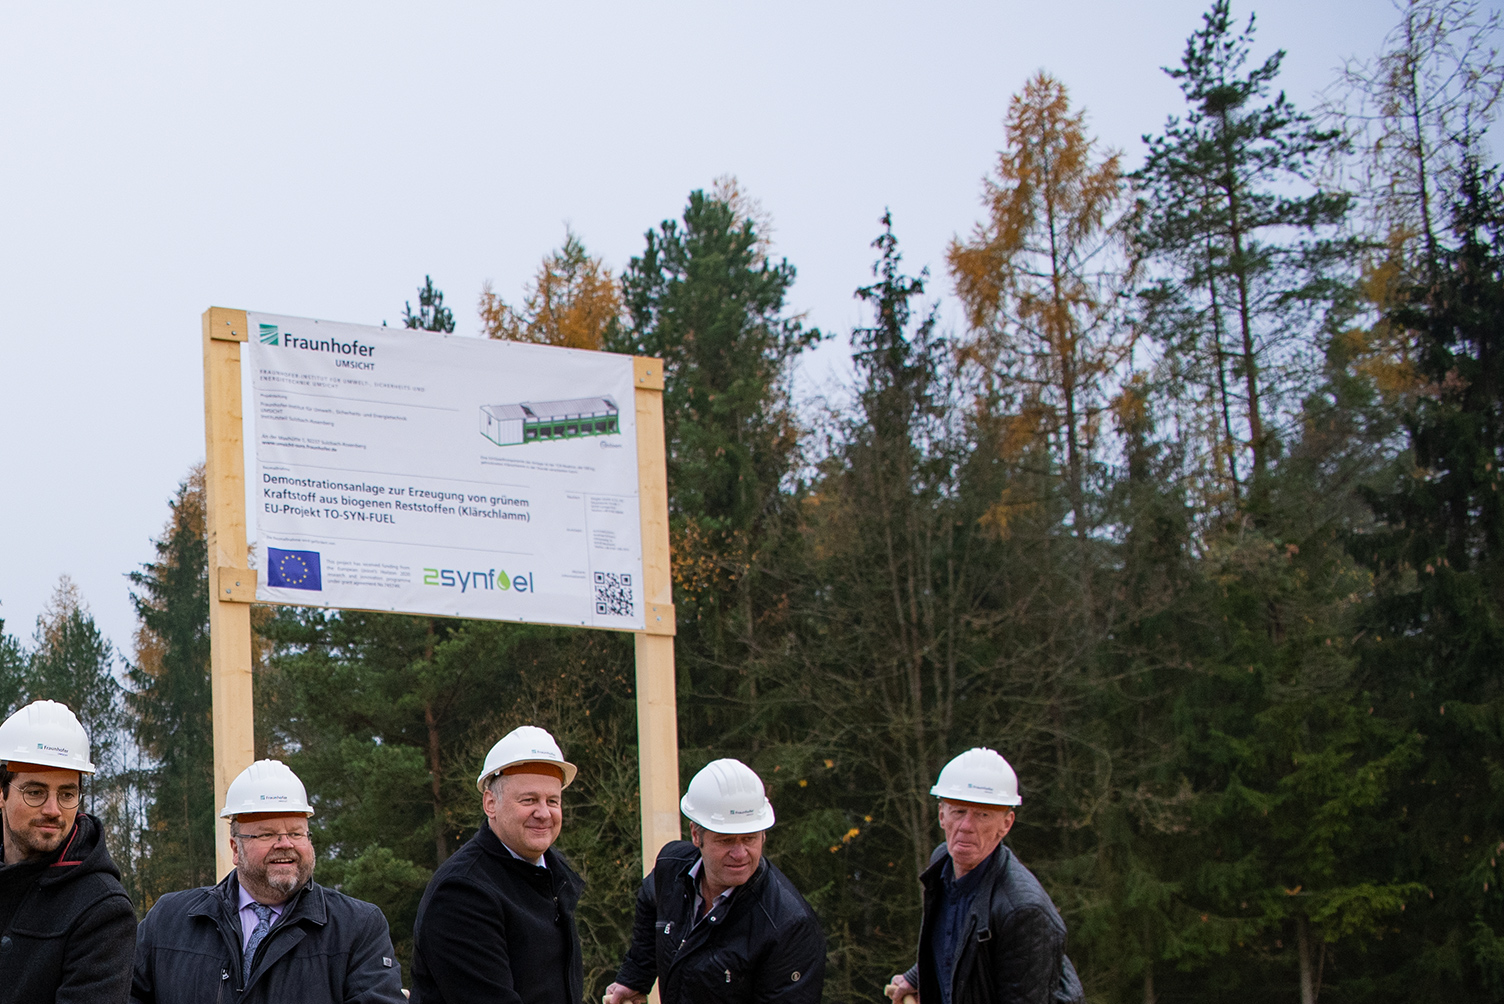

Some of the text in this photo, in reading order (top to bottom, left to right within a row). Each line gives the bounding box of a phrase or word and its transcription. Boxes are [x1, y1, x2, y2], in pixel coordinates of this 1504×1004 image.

[284, 333, 375, 358] Fraunhofer
[335, 359, 375, 371] UMSICHT
[263, 473, 529, 507] Demonstrationsanlage zur Erzeugung von grünem
[263, 488, 531, 523] Kraftstoff aus biogenen Reststoffen (Klärschlamm)
[264, 503, 396, 524] EU-Projekt TO-SYN-FUEL
[43, 745, 69, 753] Fraunhofer
